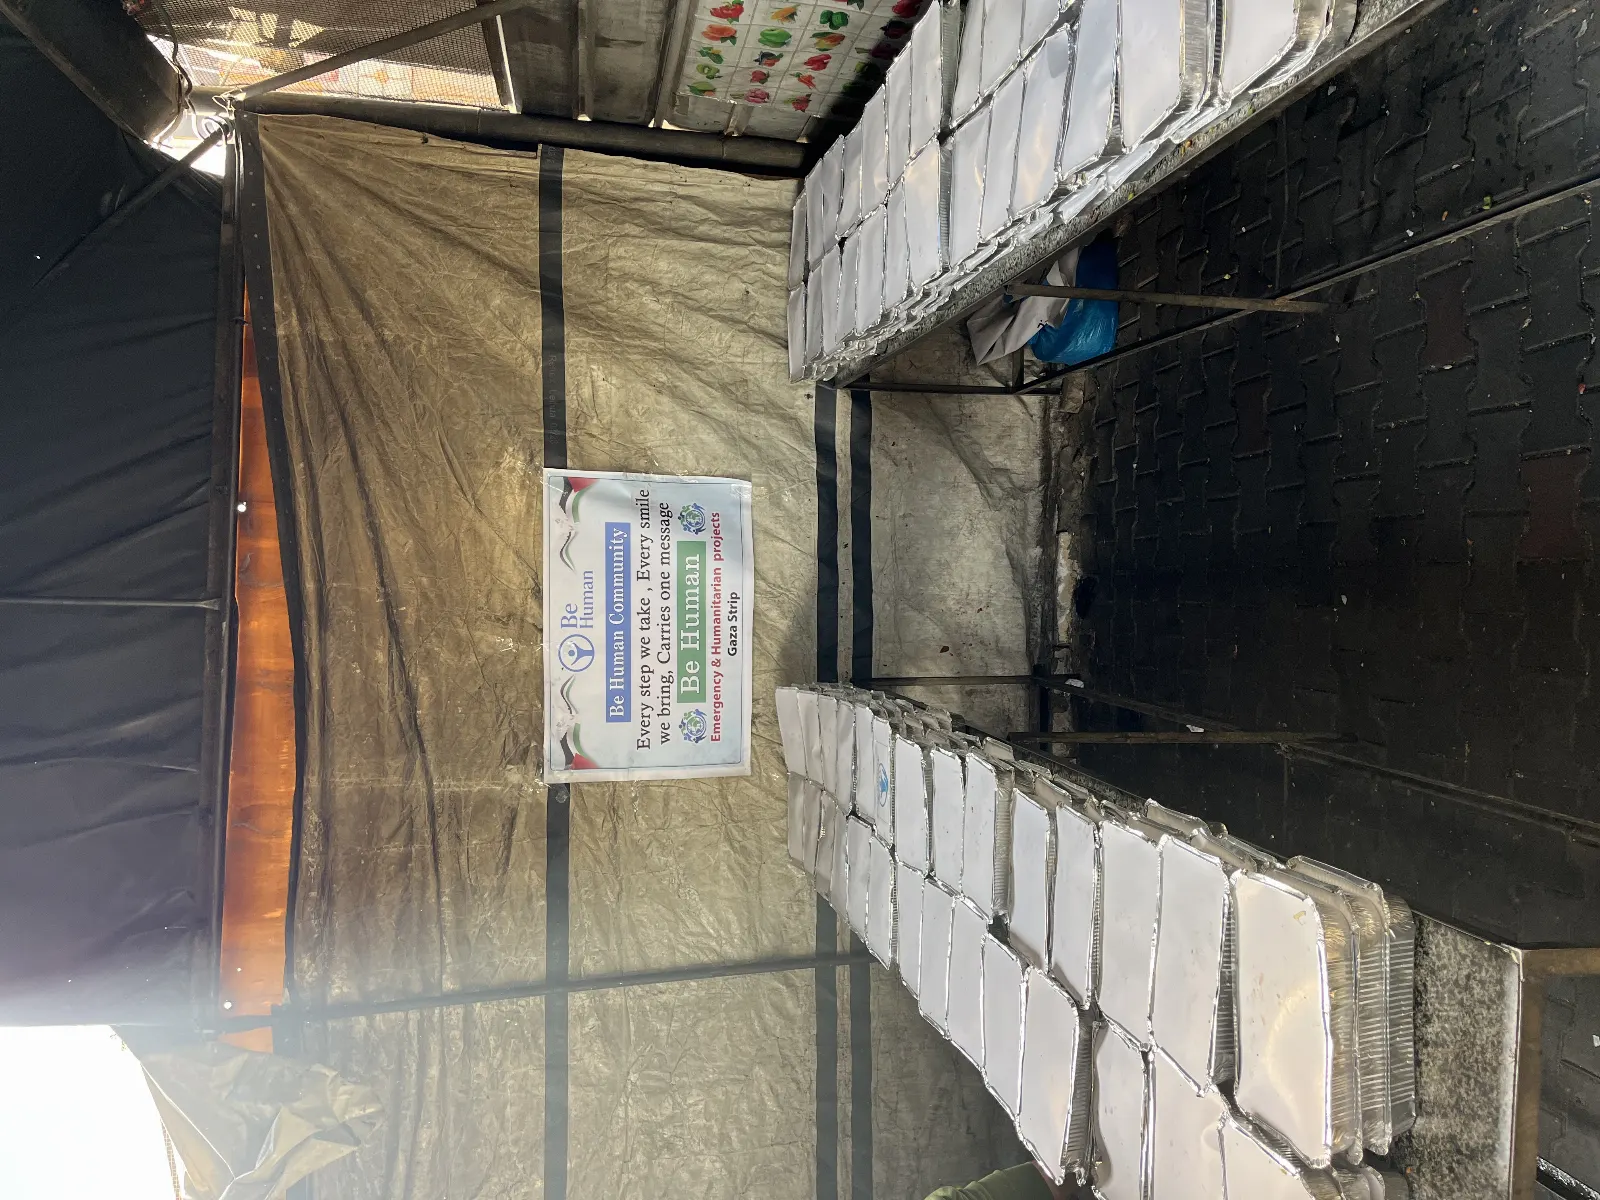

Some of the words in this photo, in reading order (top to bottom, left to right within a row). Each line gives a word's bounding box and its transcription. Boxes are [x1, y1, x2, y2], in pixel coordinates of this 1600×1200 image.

[636, 490, 650, 529] smile
[659, 502, 673, 566] message
[710, 512, 722, 561] projects
[609, 528, 627, 624] Community
[637, 535, 652, 581] Every
[580, 570, 594, 628] Human
[660, 572, 671, 600] one
[681, 554, 700, 650] Human
[727, 592, 740, 622] Strip
[560, 603, 578, 628] Be
[637, 598, 650, 631] take
[711, 567, 721, 654] Humanitarian
[640, 636, 651, 659] we
[657, 606, 671, 664] Carries
[728, 625, 738, 656] Gaza
[610, 631, 624, 690] Human
[639, 665, 654, 697] step
[681, 661, 700, 693] Be
[711, 658, 721, 667] &
[610, 695, 624, 717] Be
[657, 670, 673, 716] bring,
[711, 671, 723, 741] Emergency
[637, 703, 653, 749] Every
[660, 722, 671, 744] we
